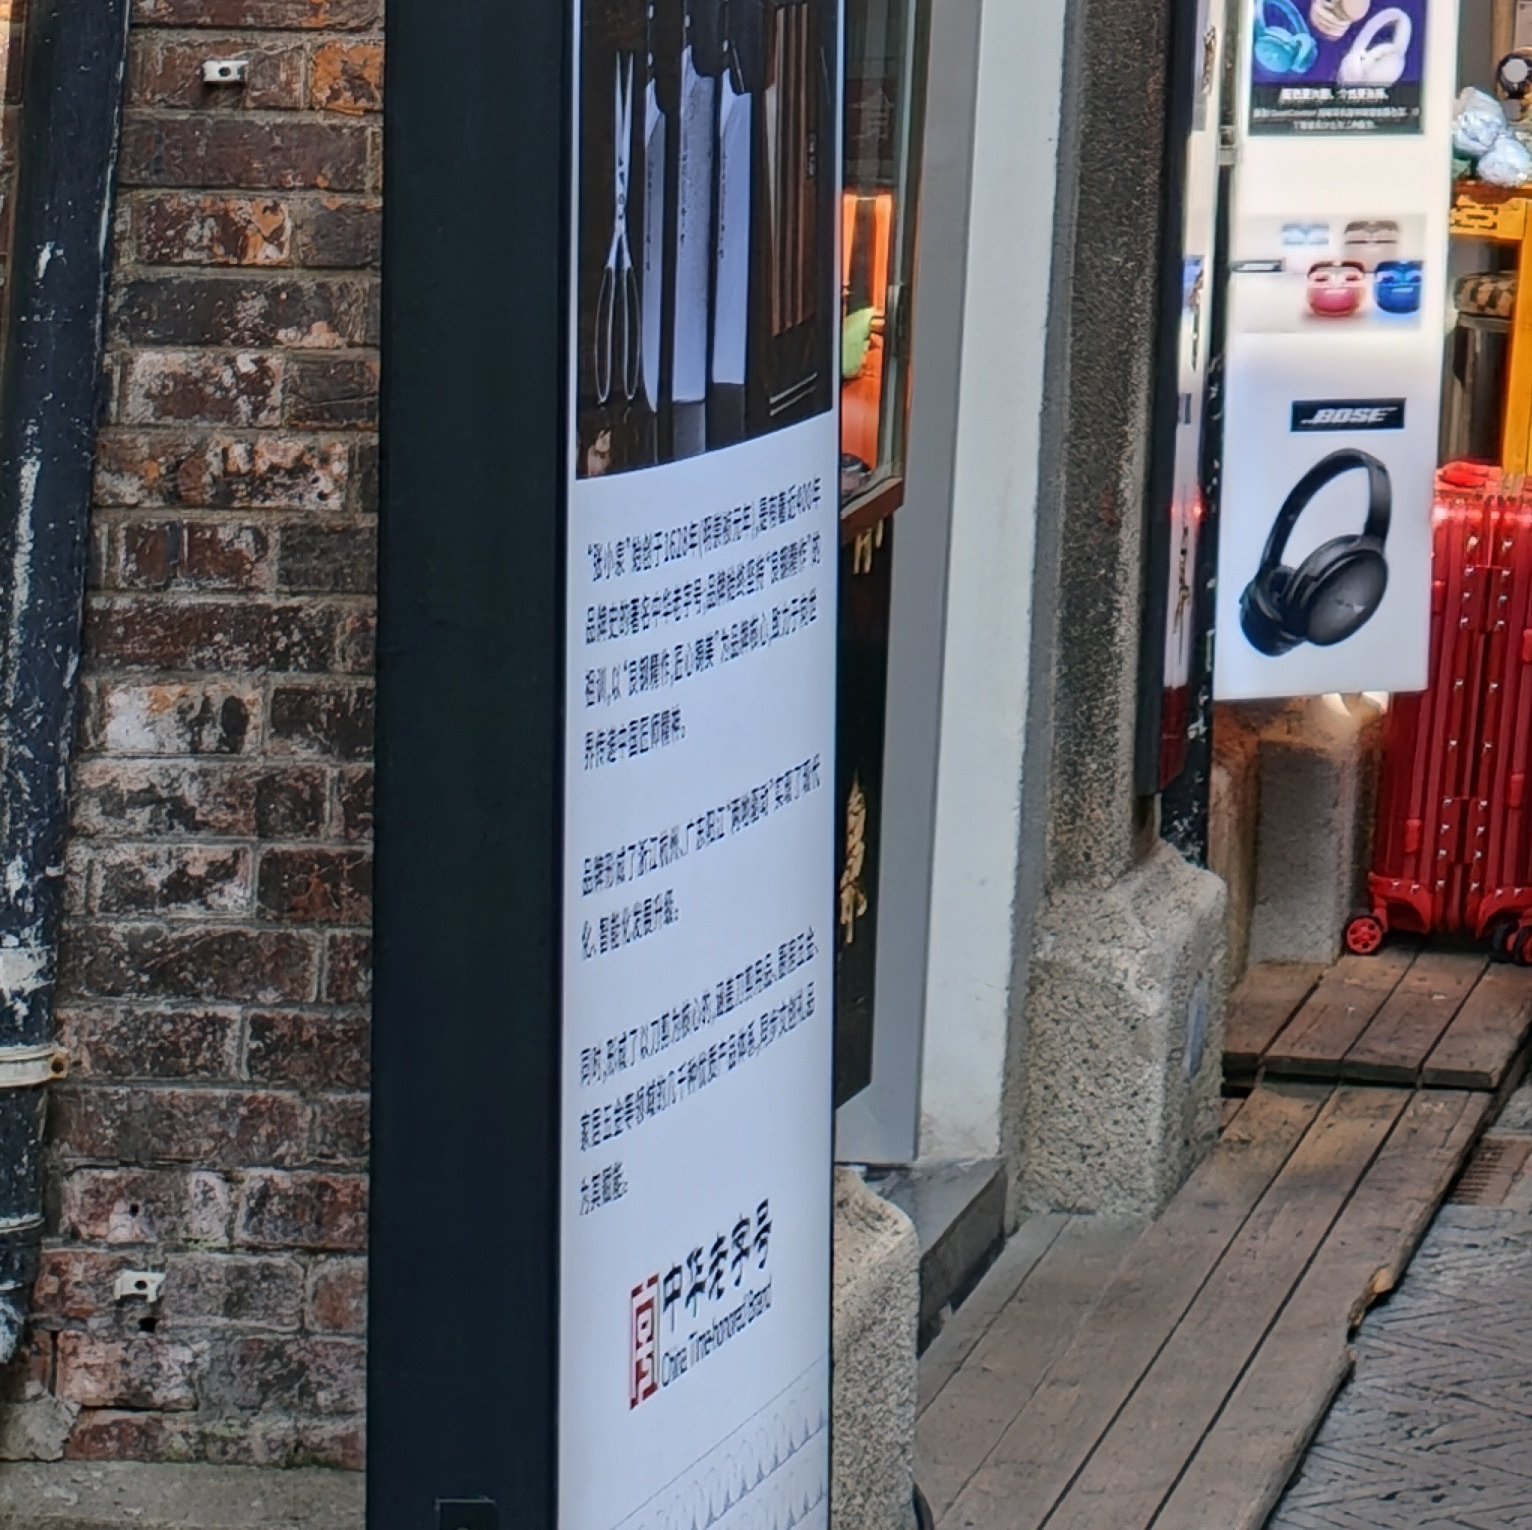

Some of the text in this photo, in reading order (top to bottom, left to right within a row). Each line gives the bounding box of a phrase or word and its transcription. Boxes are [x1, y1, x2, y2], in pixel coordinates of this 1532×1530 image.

[1301, 406, 1398, 425] BOSE
[662, 1198, 773, 1333] 中华老字号
